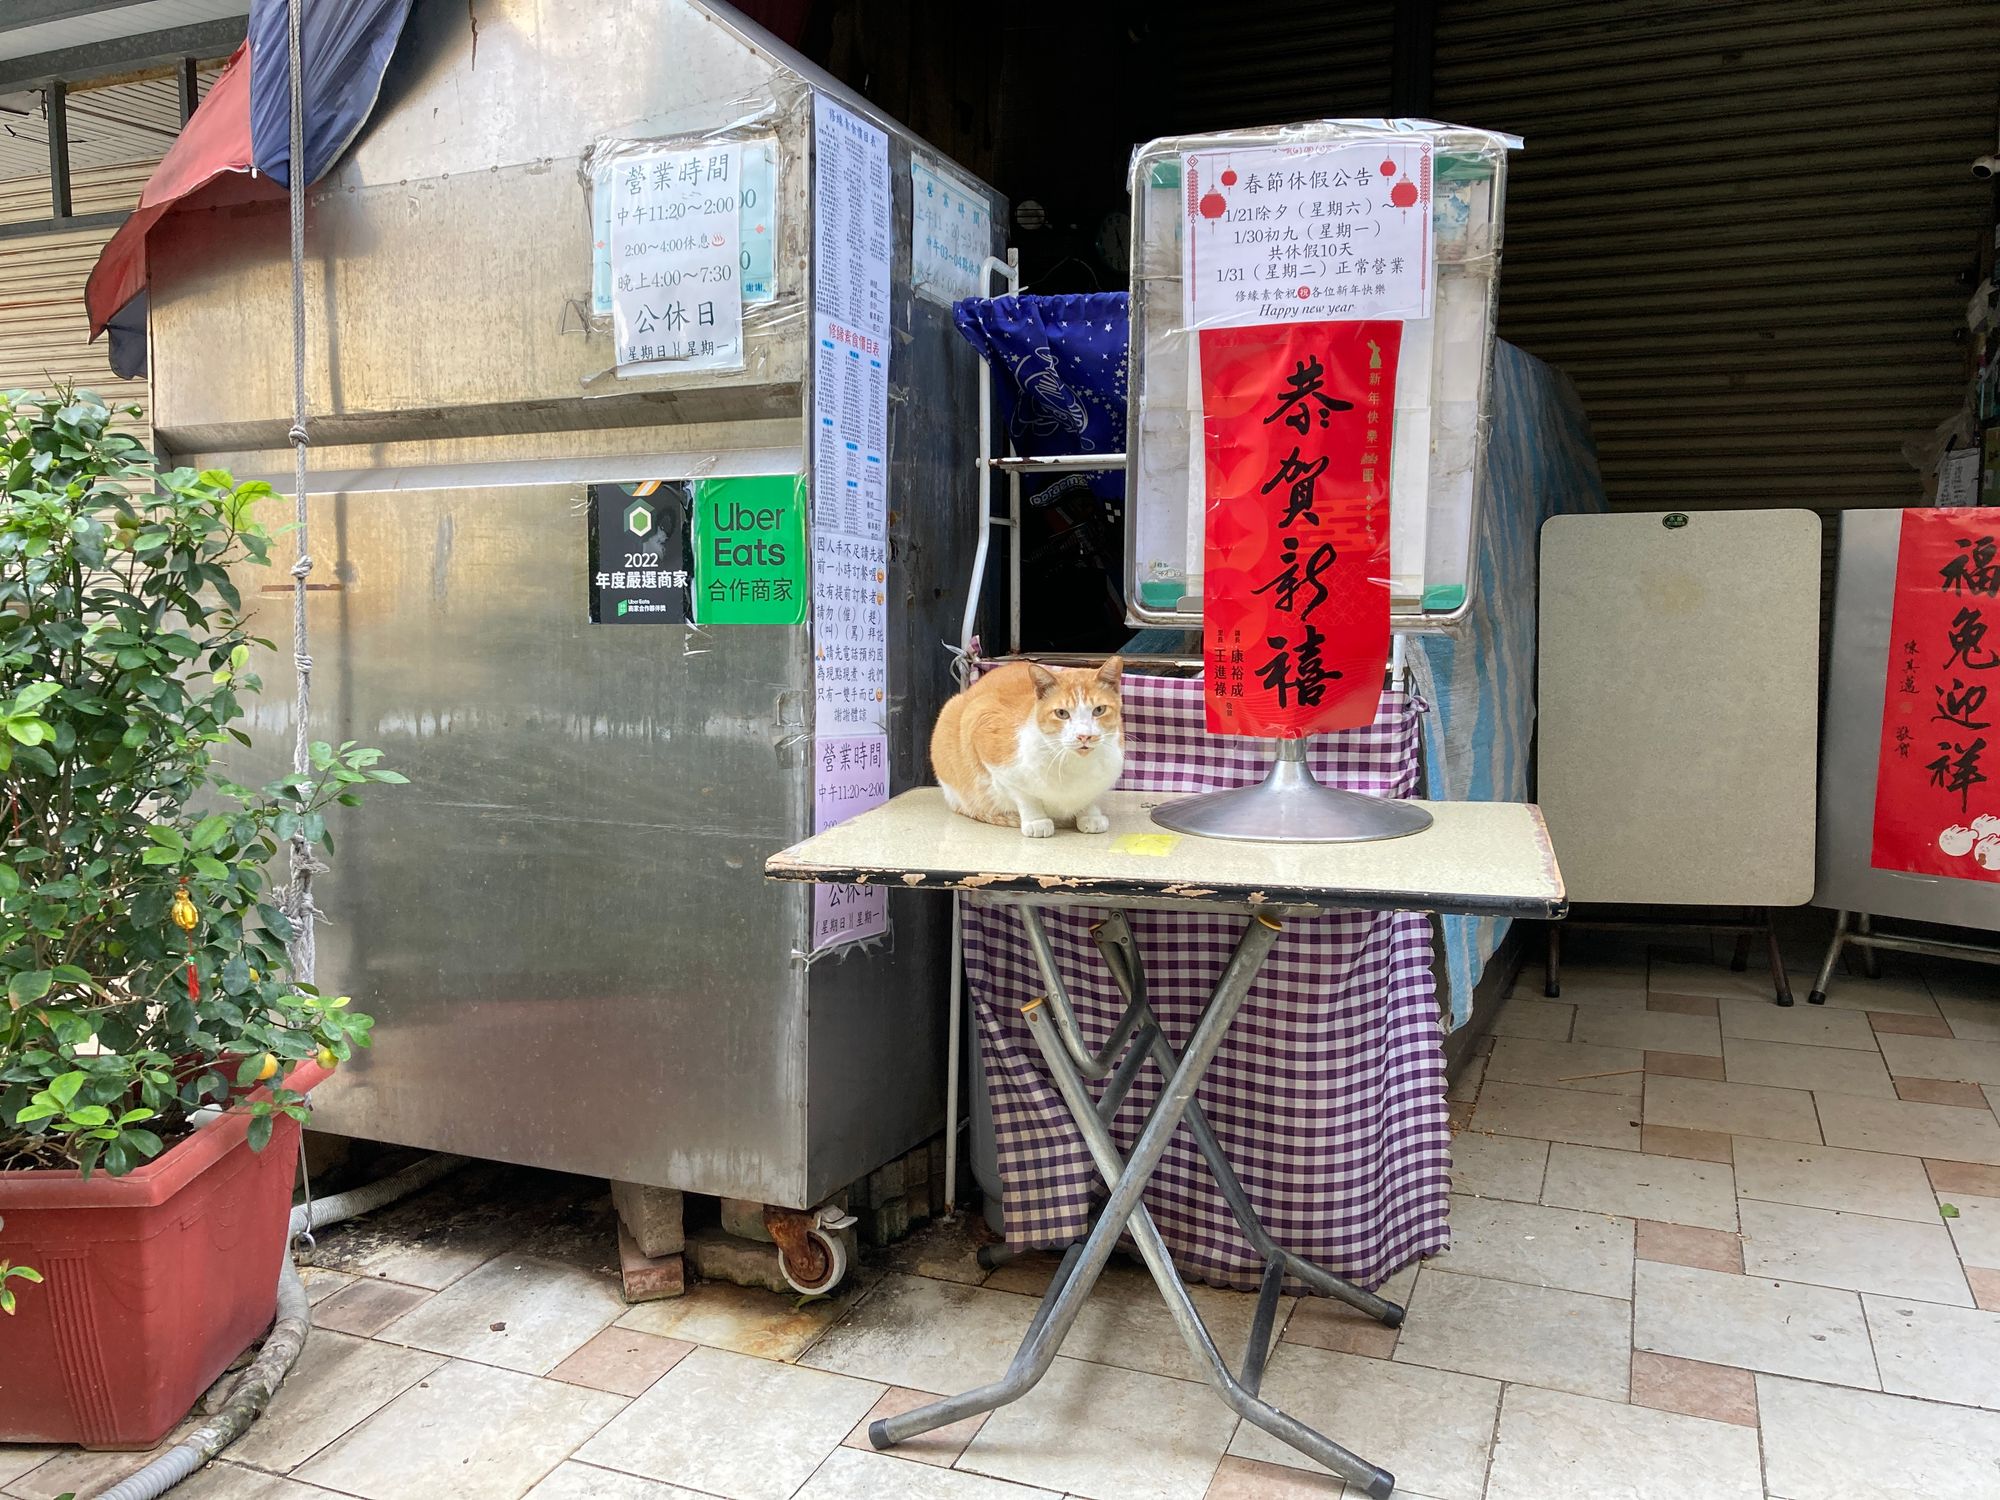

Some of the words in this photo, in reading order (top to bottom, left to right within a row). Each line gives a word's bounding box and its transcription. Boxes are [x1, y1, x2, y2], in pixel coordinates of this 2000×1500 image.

[625, 153, 729, 195] 營業時間
[1243, 167, 1373, 194] 春節休假公告
[1269, 242, 1354, 260] 共休假10天
[634, 300, 715, 334] 公休日
[1258, 303, 1299, 319] Happy
[1302, 305, 1325, 315] new
[1327, 303, 1355, 317] year
[1366, 372, 1382, 444] 新年快樂
[714, 502, 785, 532] Uber
[1251, 354, 1354, 709] 恭賀新禧
[624, 552, 659, 568] 2022
[714, 537, 786, 567] Eats
[817, 536, 885, 564] 因人手不足請先提
[595, 569, 689, 589] 年度嚴選商家
[817, 559, 877, 582] 前一小時訂餐喔
[708, 577, 793, 602] 合作商家
[817, 583, 877, 605] 沒有提前訂餐者
[826, 645, 884, 662] 請先電話預約因
[1231, 648, 1244, 697] 康裕成
[1925, 535, 2000, 814] 福兔迎祥
[817, 686, 875, 704] 只有一雙手而已
[834, 707, 867, 723] 謝謝體諒
[822, 742, 882, 772] 營業時間
